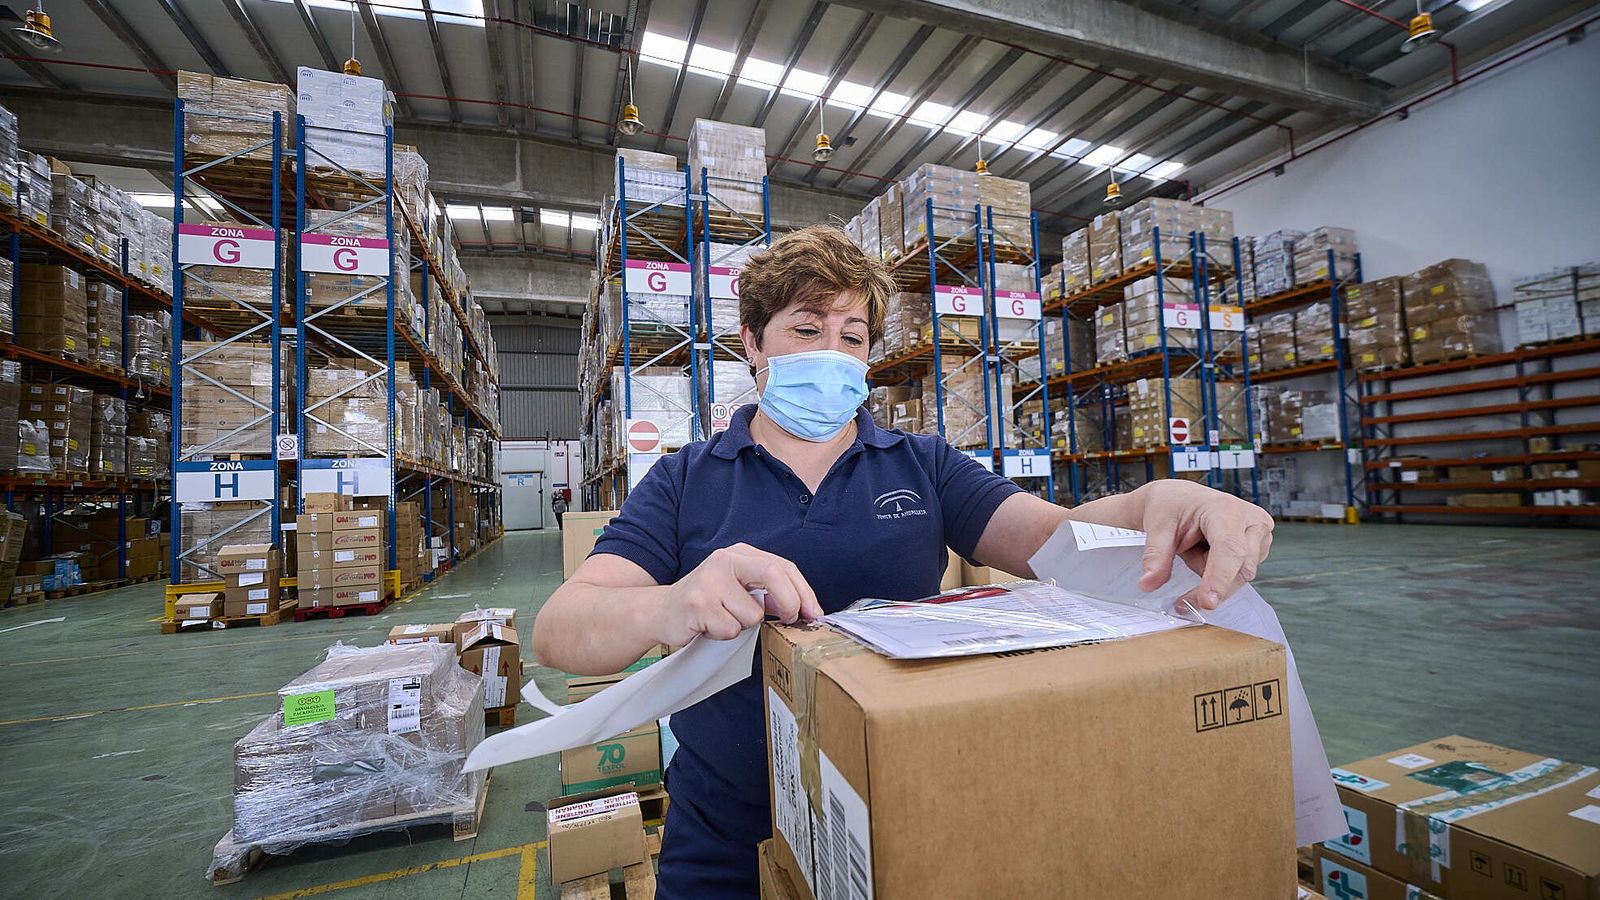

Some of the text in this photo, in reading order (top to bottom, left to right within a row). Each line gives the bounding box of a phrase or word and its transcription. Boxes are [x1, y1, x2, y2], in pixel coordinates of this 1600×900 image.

[211, 228, 244, 238] ZONA
[330, 237, 361, 247] ZONA
[213, 239, 241, 264] G
[333, 248, 359, 272] G
[646, 262, 669, 270] ZONA
[647, 272, 667, 292] G
[952, 295, 966, 312] G
[1011, 300, 1024, 316] G
[1176, 311, 1187, 326] G
[1223, 313, 1232, 328] S
[715, 408, 725, 416] 10
[209, 462, 244, 471] ZONA
[332, 460, 355, 468] ZON
[1021, 458, 1032, 474] H
[1188, 453, 1197, 468] H
[1232, 453, 1240, 467] T
[214, 473, 239, 498] H
[337, 471, 359, 495] H
[517, 478, 525, 486] R
[596, 743, 625, 766] 70
